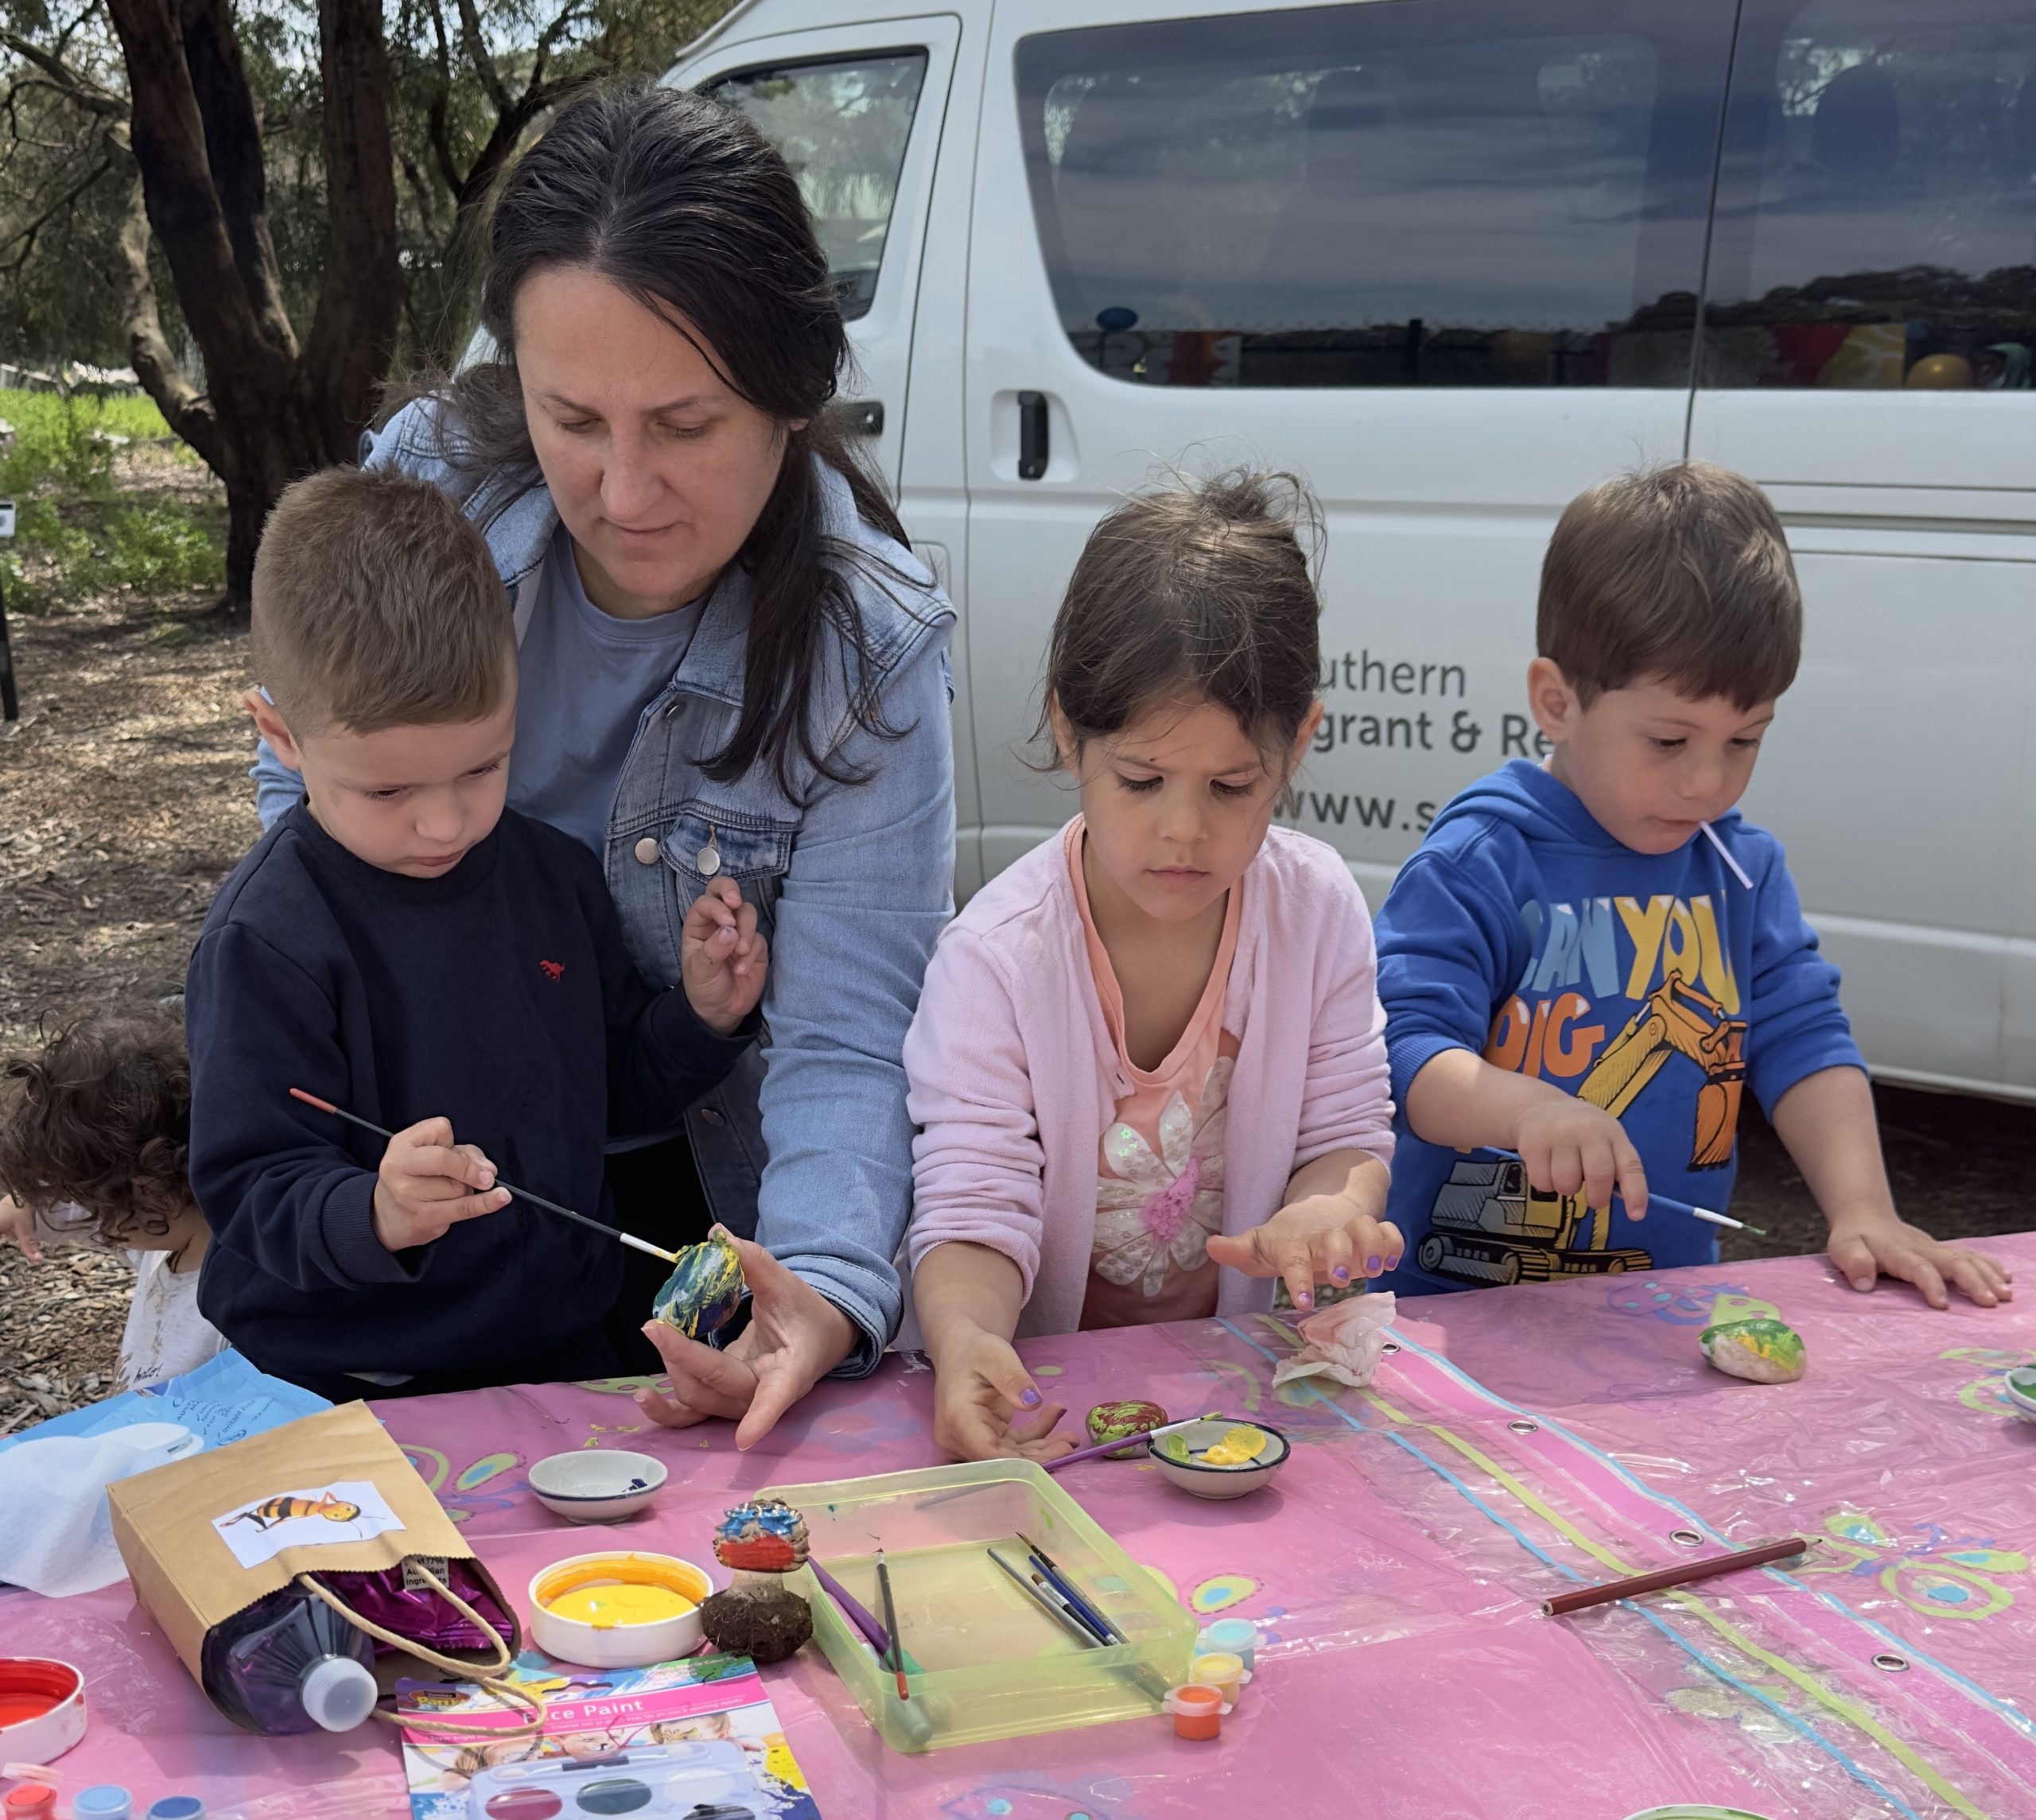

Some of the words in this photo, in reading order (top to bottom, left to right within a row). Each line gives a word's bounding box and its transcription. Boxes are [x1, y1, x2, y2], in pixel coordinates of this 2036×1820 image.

[1451, 710, 1482, 754] &
[1613, 889, 1741, 1016] YOU
[1483, 992, 1606, 1079] DIG
[523, 1707, 575, 1725] Fce
[584, 1701, 645, 1717] Paint
